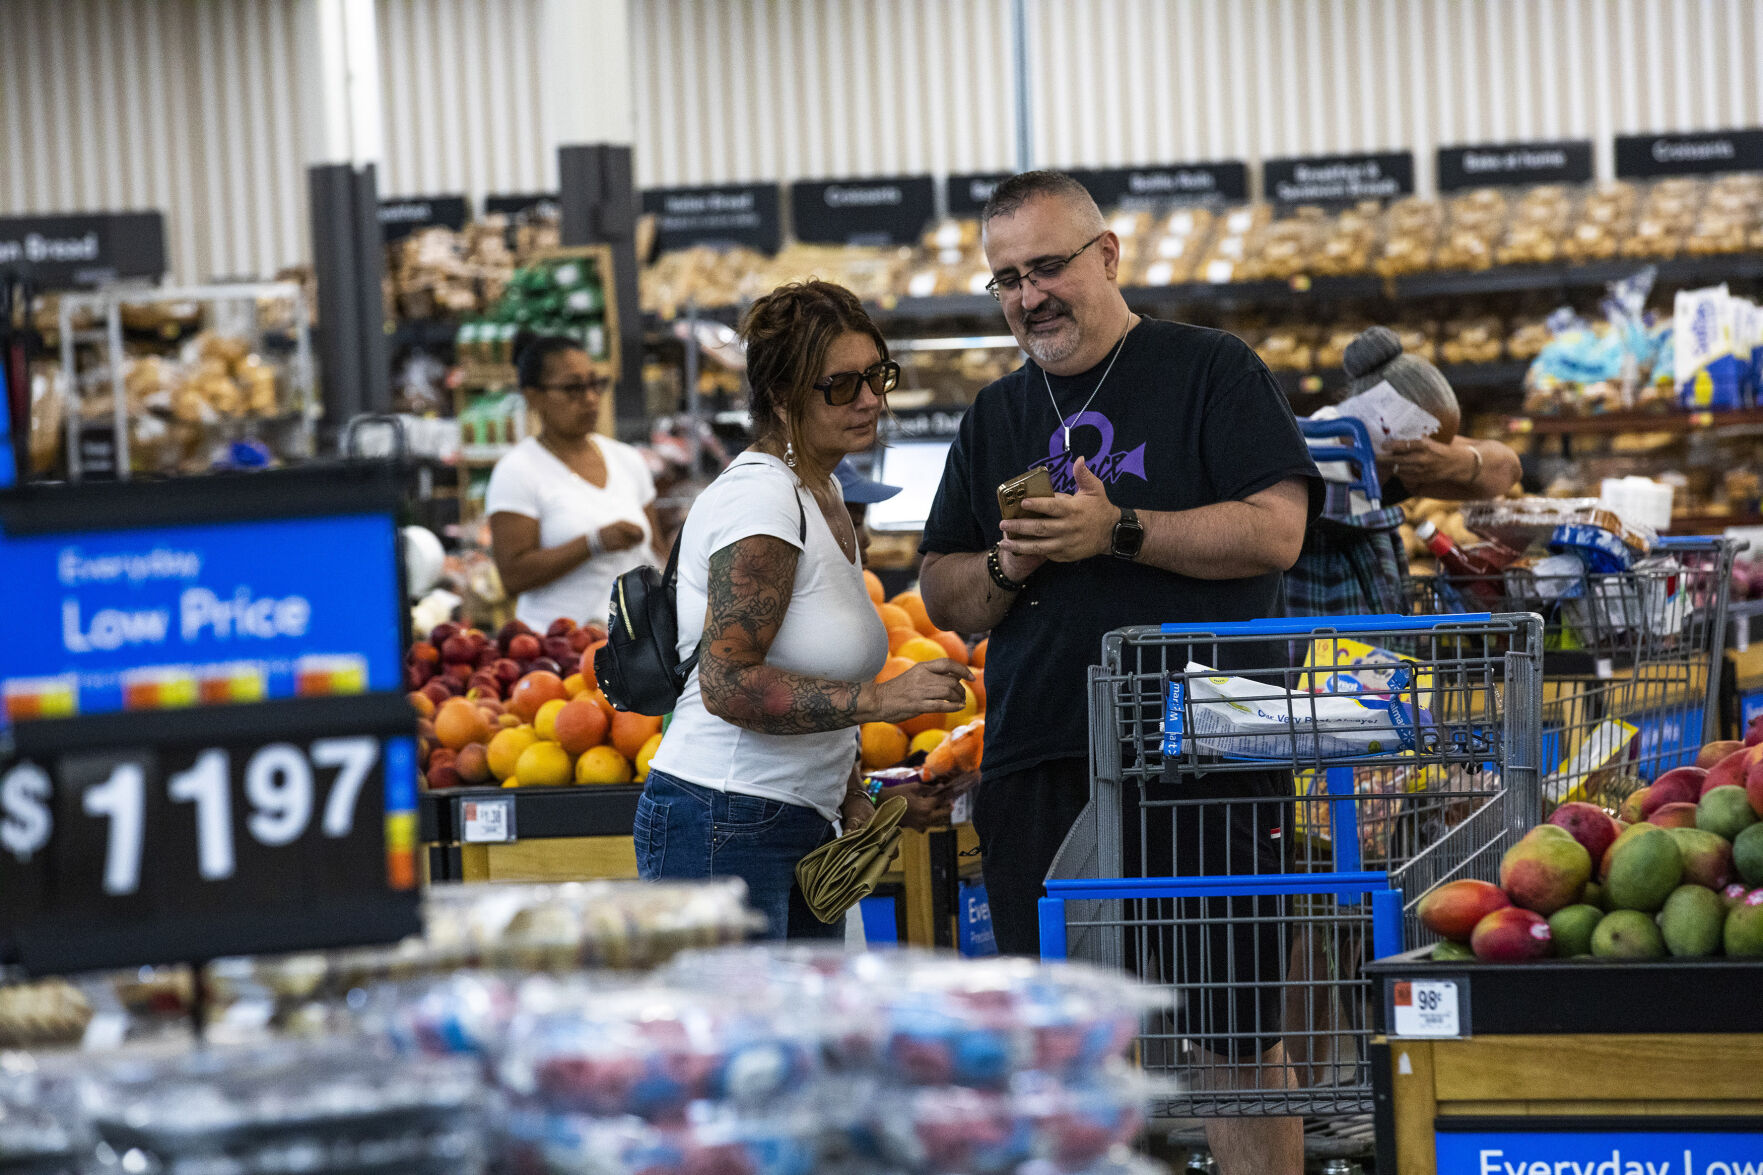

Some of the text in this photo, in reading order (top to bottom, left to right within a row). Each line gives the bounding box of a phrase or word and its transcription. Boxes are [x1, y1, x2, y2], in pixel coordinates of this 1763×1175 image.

[59, 546, 203, 586] Everyday
[62, 585, 311, 652] Low Price
